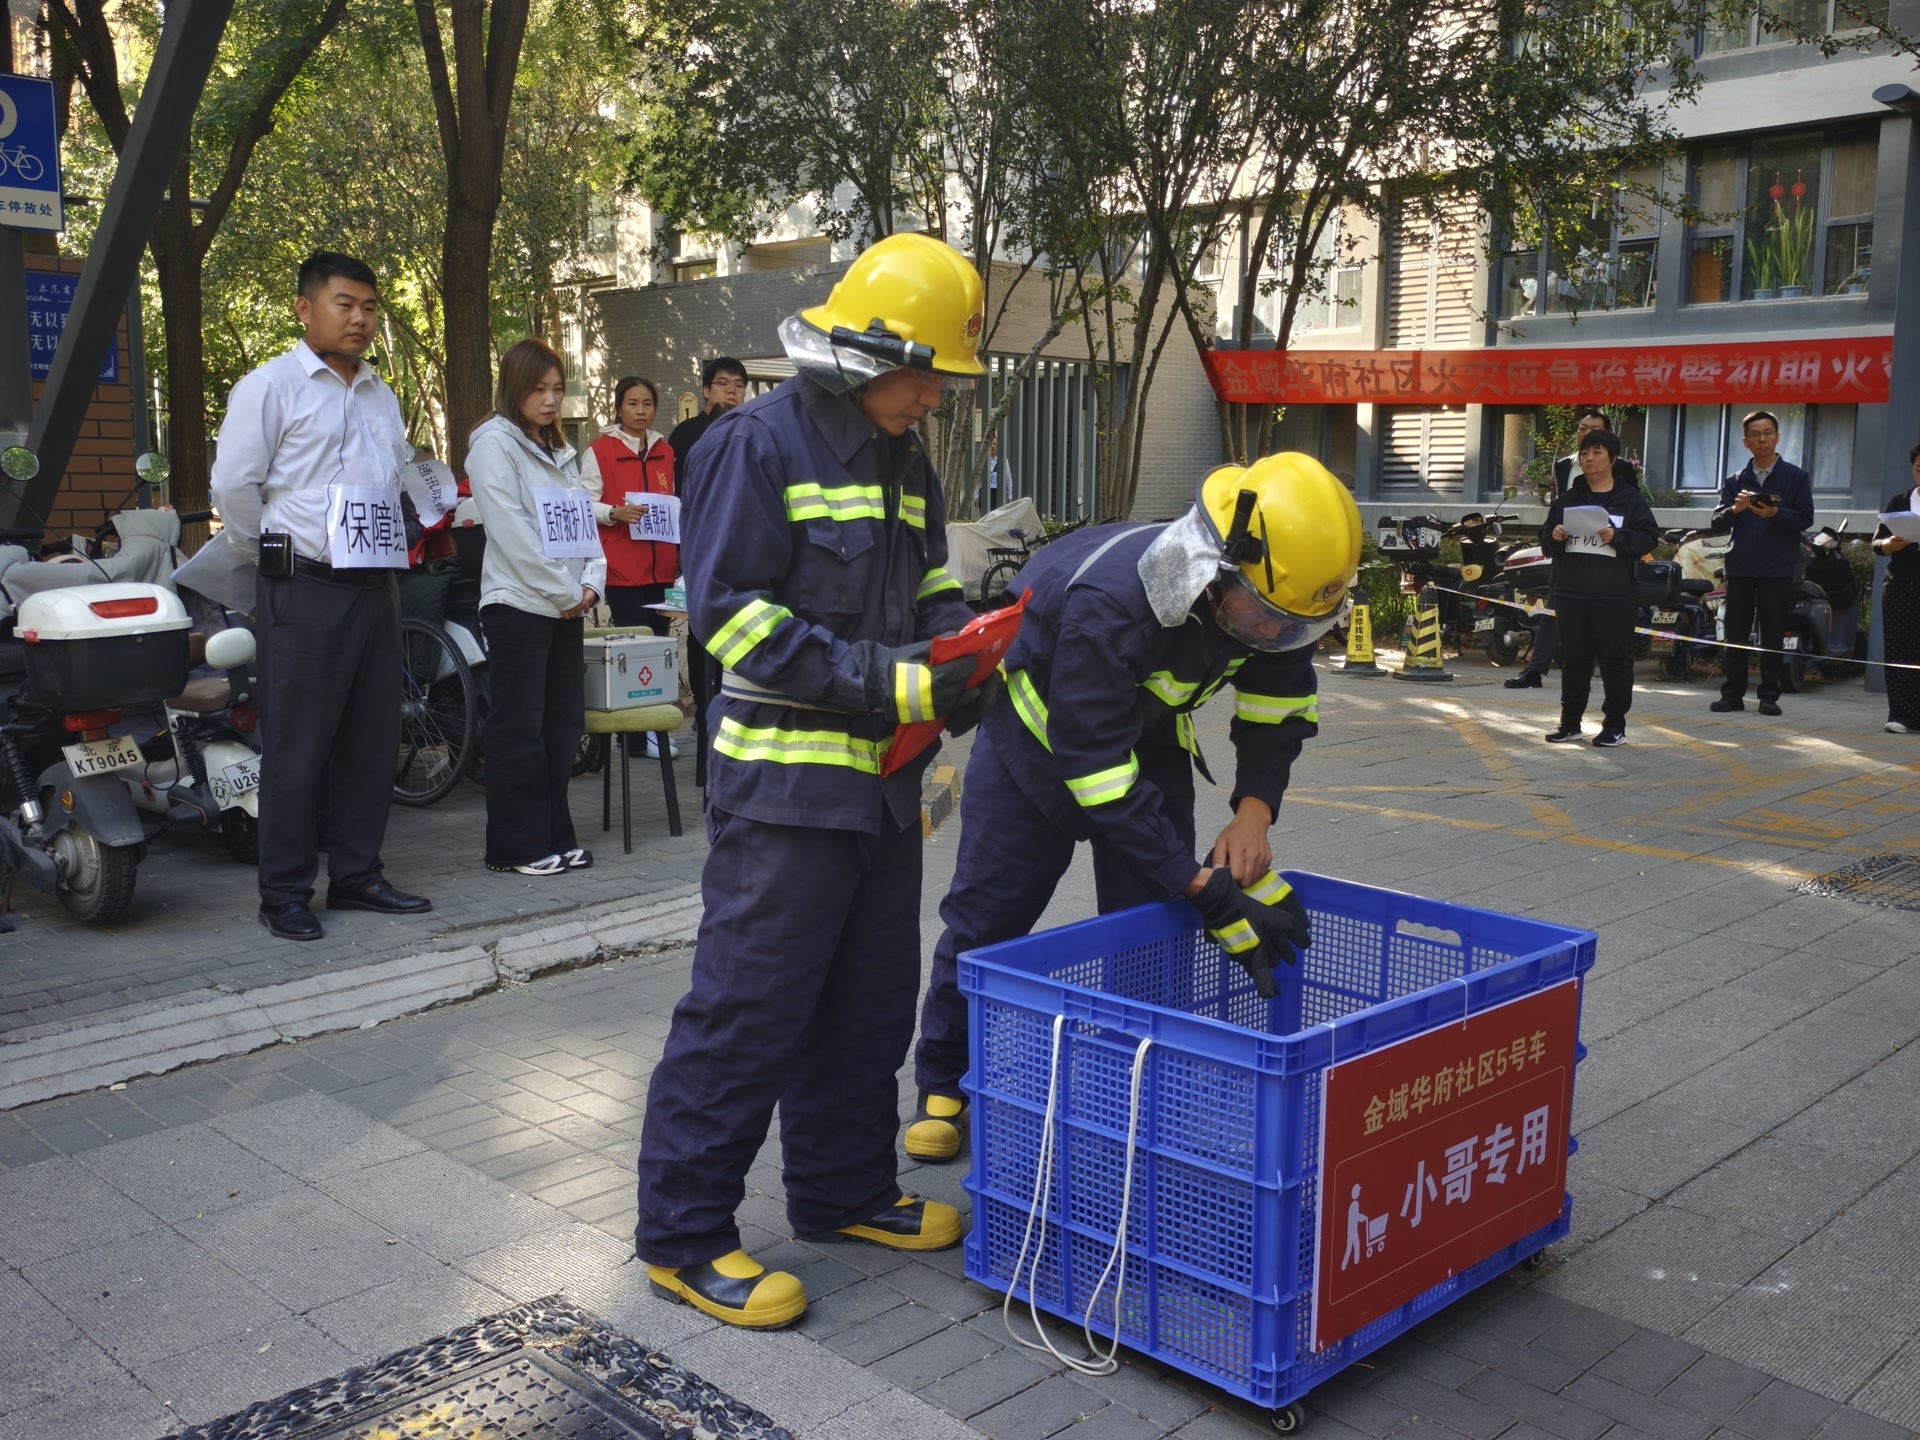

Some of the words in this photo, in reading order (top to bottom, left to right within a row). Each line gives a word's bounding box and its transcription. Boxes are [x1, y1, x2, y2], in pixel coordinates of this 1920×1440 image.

[543, 500, 596, 542] 医疗救护人员
[1355, 608, 1364, 651] 装修找物业
[75, 750, 138, 774] KT9045
[233, 771, 260, 790] U26
[1363, 1030, 1547, 1136] 金域华府社区5号车
[1400, 1104, 1550, 1229] 小哥专用
